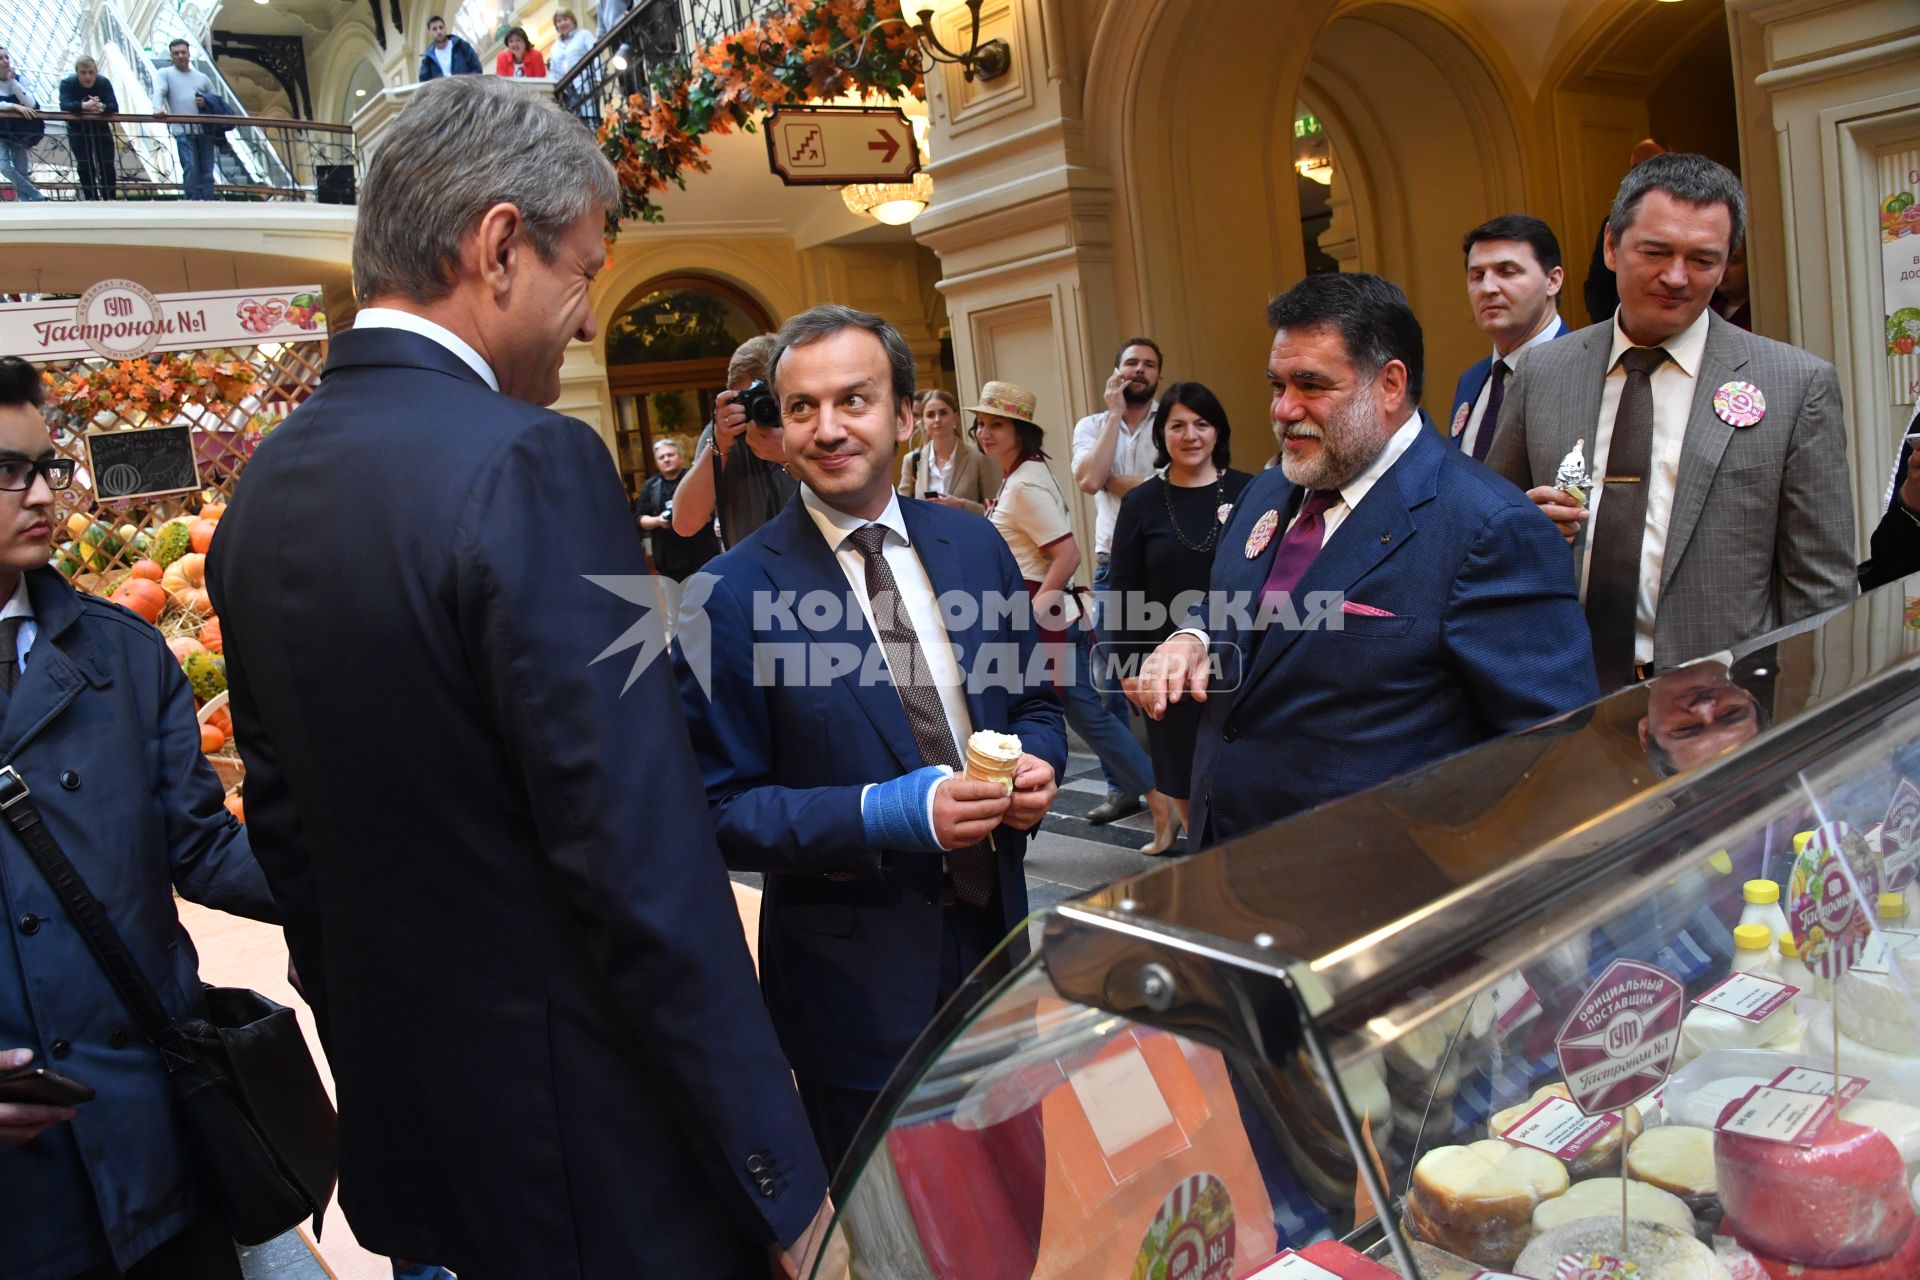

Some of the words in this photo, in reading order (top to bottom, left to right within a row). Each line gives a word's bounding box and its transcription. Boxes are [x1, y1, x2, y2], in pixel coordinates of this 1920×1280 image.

[104, 297, 133, 317] ГУМ
[33, 317, 175, 347] Гастроном
[177, 310, 207, 334] №1
[1579, 978, 1664, 1022] ОФИЦИАЛЬНЫЙ
[1585, 994, 1655, 1031] ПОСТАВЩИК
[1609, 1019, 1638, 1050] ГУМ
[1579, 1053, 1651, 1090] Гастроном
[1653, 1037, 1669, 1055] №1
[1210, 1235, 1226, 1266] №1
